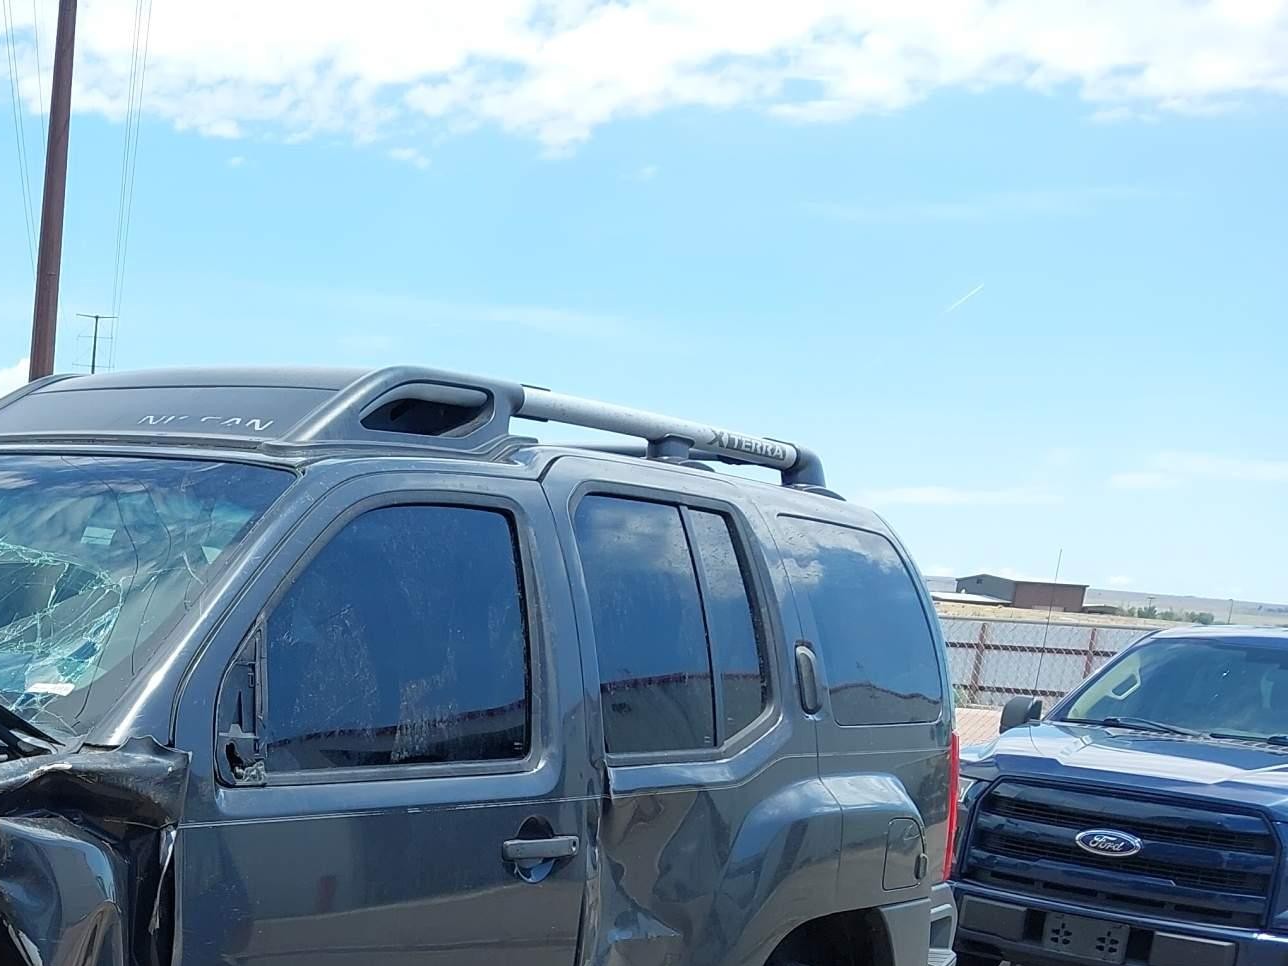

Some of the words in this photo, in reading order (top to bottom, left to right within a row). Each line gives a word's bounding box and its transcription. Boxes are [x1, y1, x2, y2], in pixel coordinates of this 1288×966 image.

[137, 414, 274, 432] NIAN
[707, 430, 785, 461] XTERRA
[1089, 834, 1125, 851] Ford
